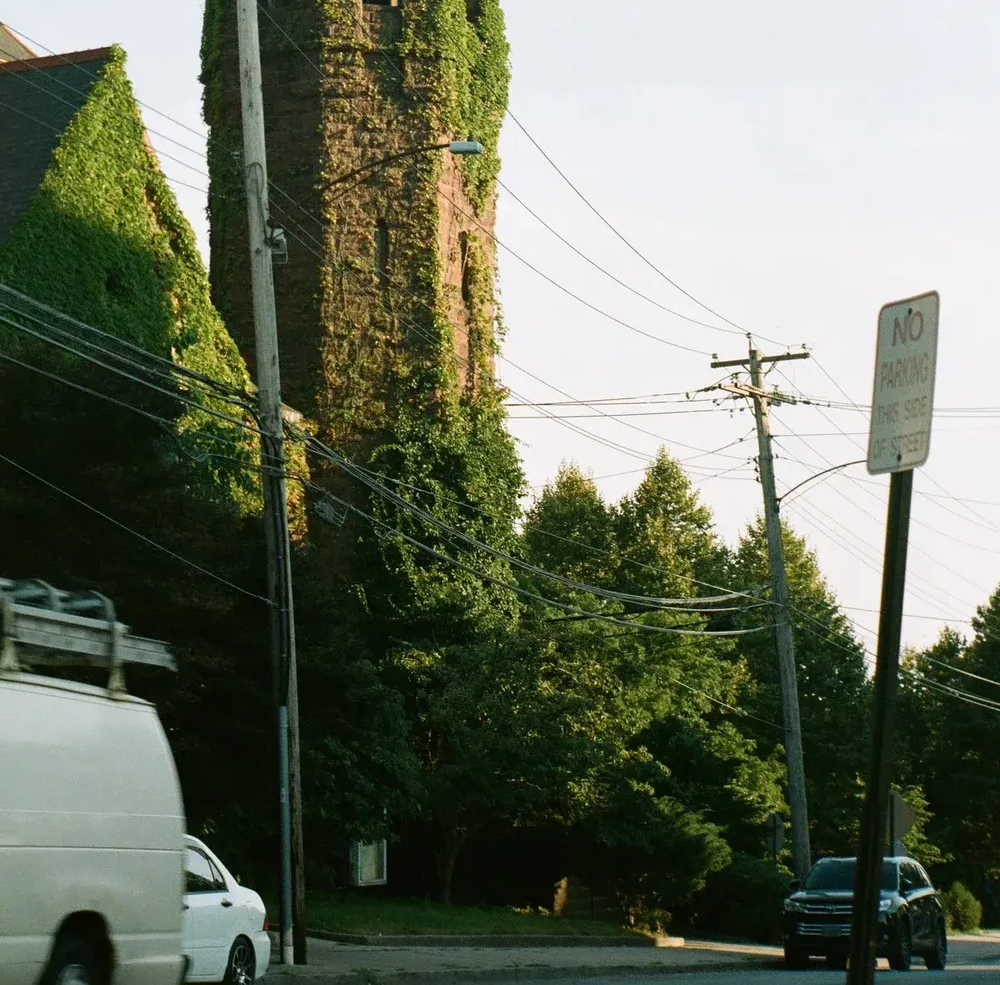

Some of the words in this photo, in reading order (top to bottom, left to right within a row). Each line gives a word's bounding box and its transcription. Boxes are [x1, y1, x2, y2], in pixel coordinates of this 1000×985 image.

[892, 311, 923, 347] NO
[880, 352, 928, 392] PARKING
[877, 402, 899, 425] THIS
[904, 396, 927, 420] SIDE
[873, 438, 886, 460] OF
[889, 430, 926, 457] STREET
